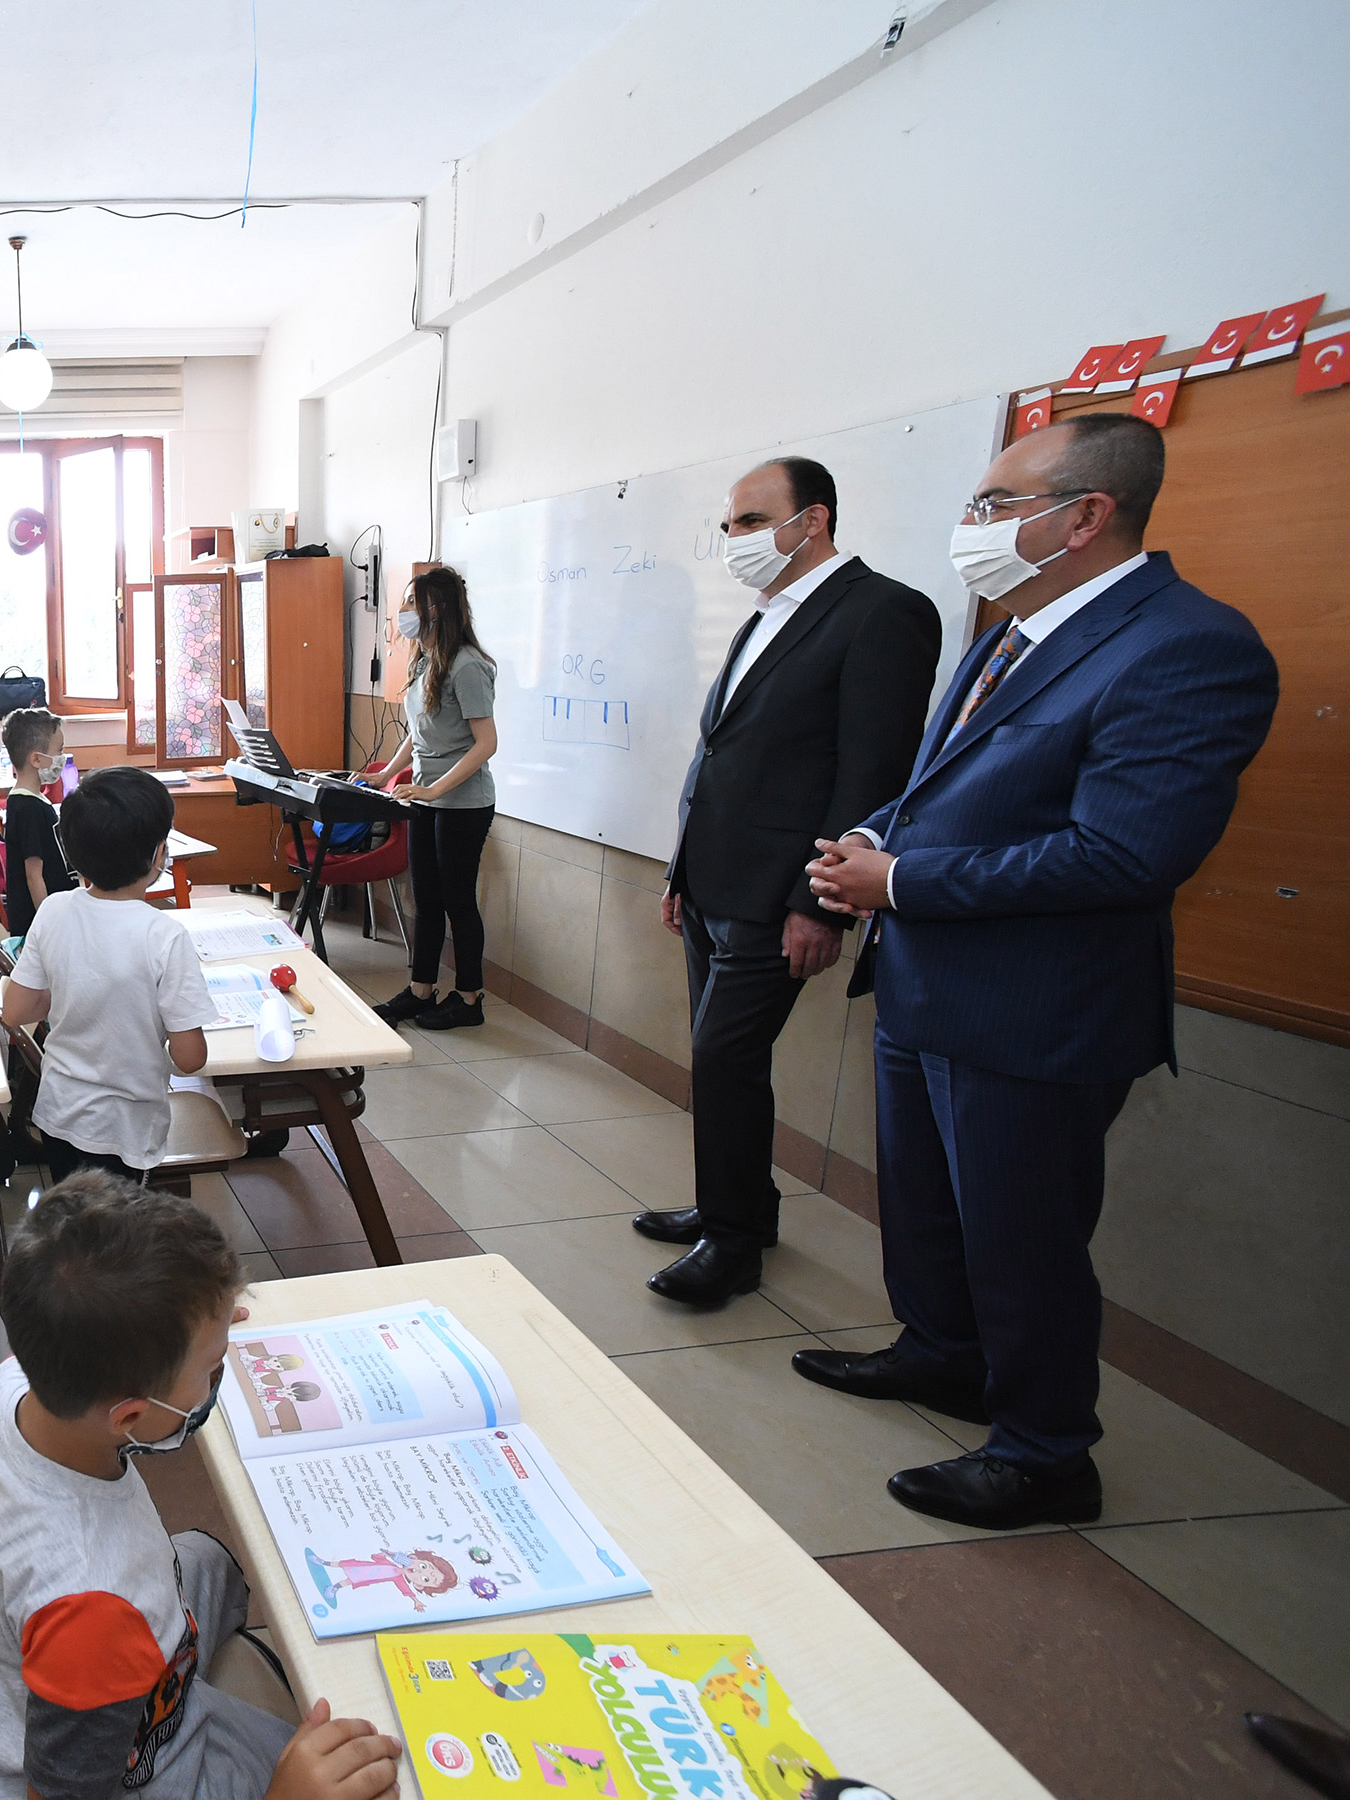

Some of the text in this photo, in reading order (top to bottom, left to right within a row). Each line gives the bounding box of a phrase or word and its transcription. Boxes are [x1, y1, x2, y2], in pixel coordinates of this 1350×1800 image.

[537, 560, 587, 584] Osman
[613, 545, 657, 575] Zeki
[562, 653, 606, 686] ORG
[409, 1445, 422, 1457] BAY
[401, 1483, 414, 1496] Bay
[508, 1485, 537, 1520] Bay Mikrop
[634, 1679, 724, 1800] TÜRK
